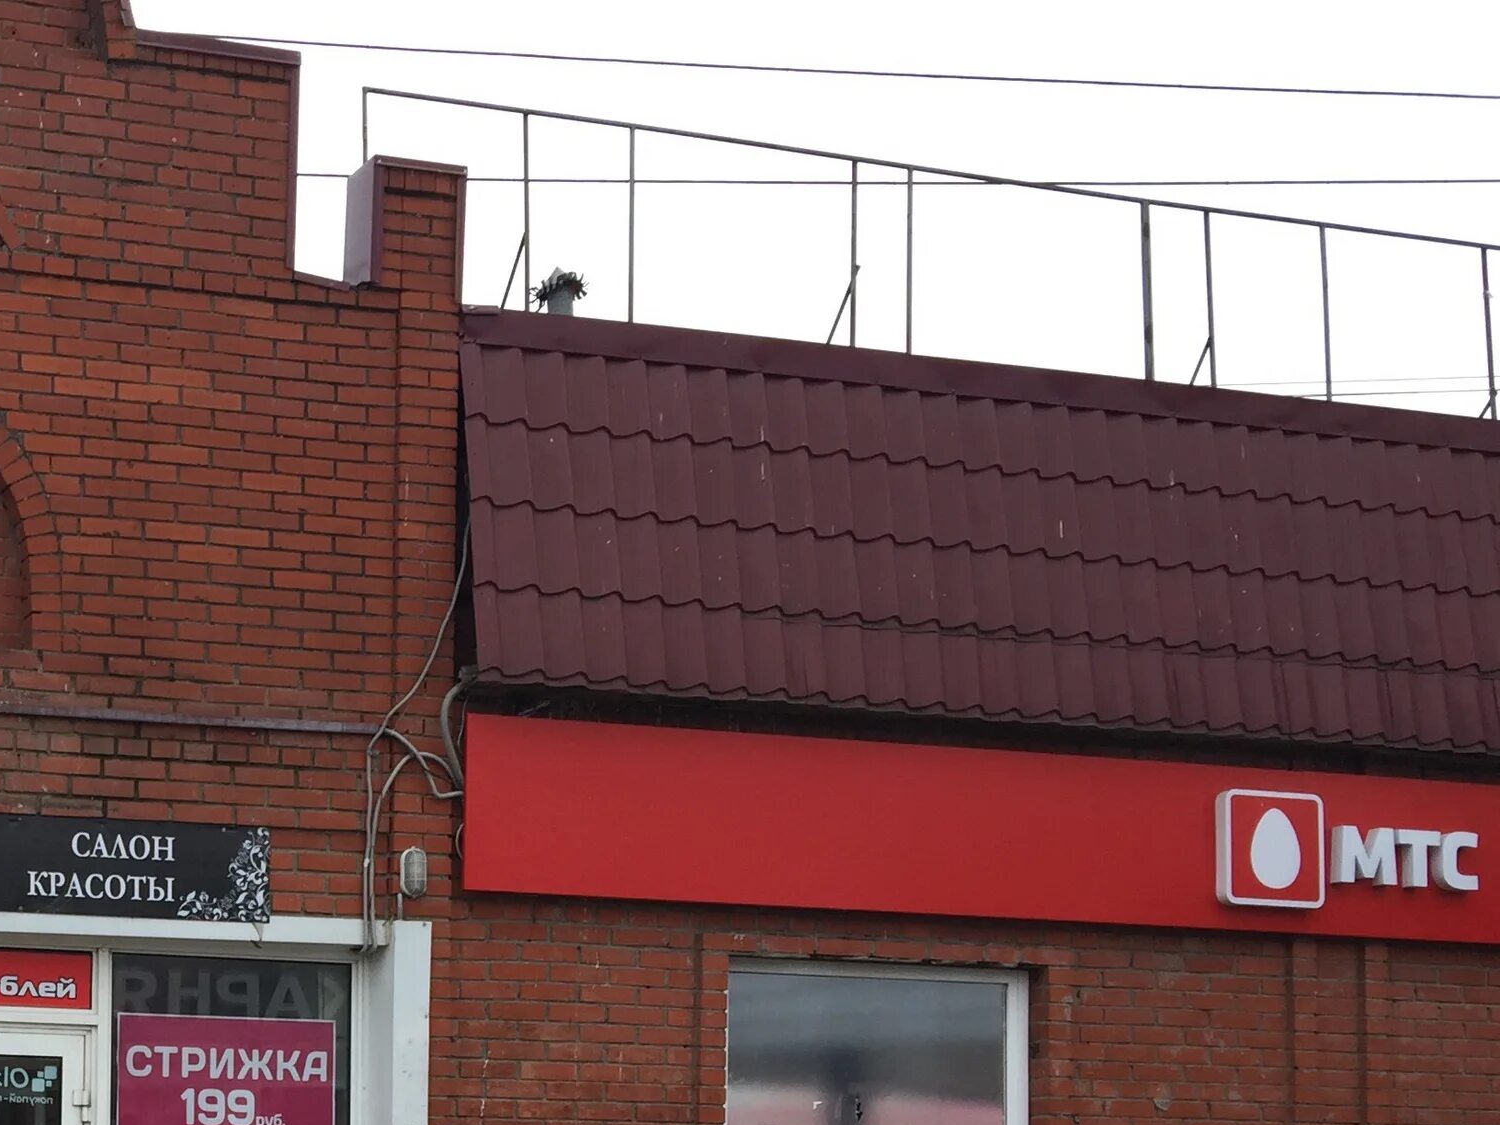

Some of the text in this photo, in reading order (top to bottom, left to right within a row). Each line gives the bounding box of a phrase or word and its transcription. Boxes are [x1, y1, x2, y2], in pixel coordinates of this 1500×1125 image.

[70, 831, 176, 862] САЛОН
[1330, 825, 1479, 891] МТС
[27, 870, 176, 903] КРАСОТЫ
[125, 1044, 329, 1083] СТРИЖКА
